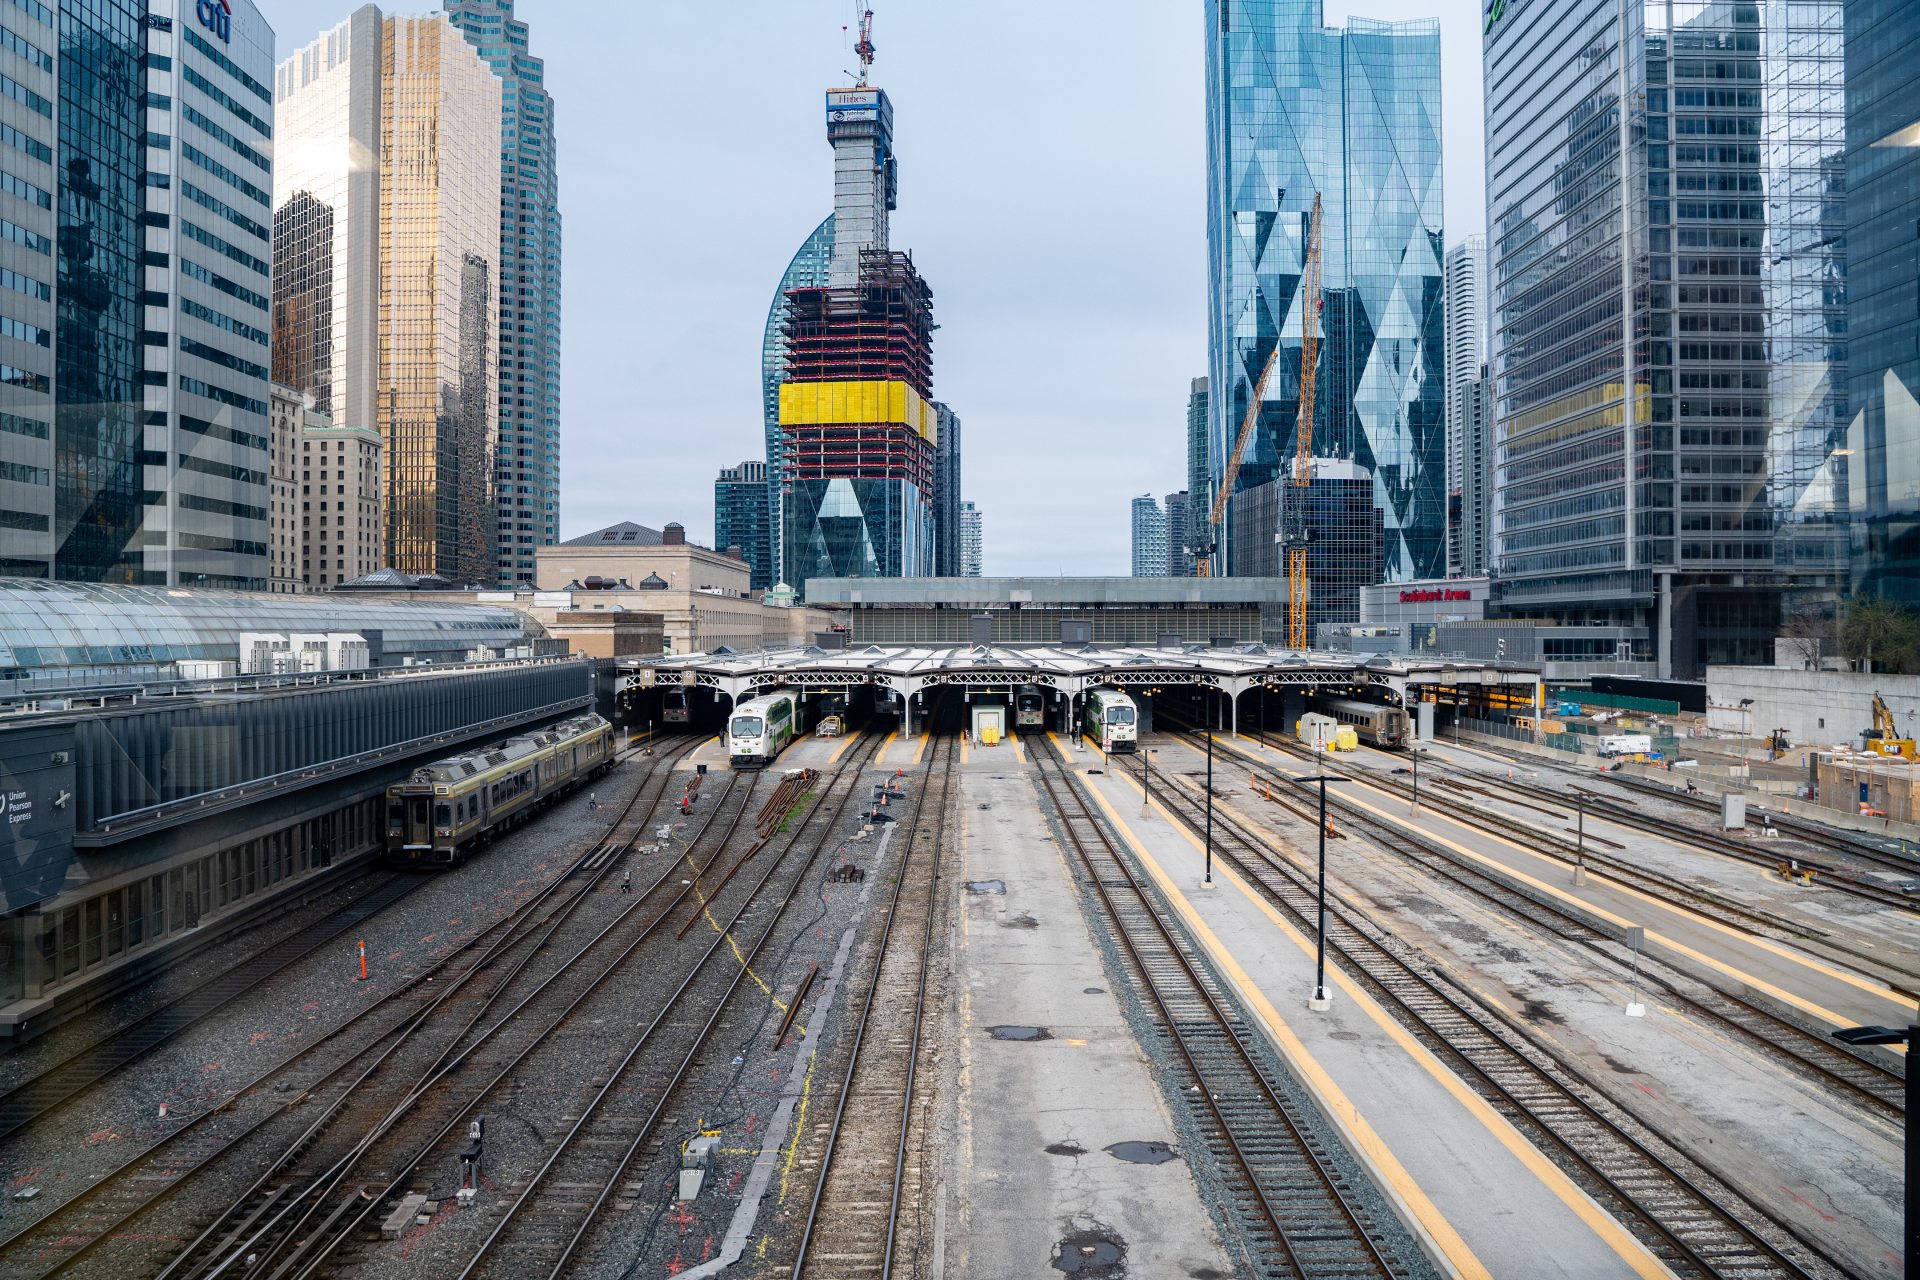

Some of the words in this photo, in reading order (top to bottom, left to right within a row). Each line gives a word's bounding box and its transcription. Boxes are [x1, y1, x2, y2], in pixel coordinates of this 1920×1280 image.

[196, 0, 231, 44] citi
[840, 94, 867, 104] Hines
[1400, 588, 1443, 602] Scotiabank
[1444, 588, 1471, 601] Arena
[1884, 744, 1899, 753] CAT
[9, 791, 26, 800] Union
[9, 801, 31, 812] Pearson
[9, 813, 31, 823] Express
